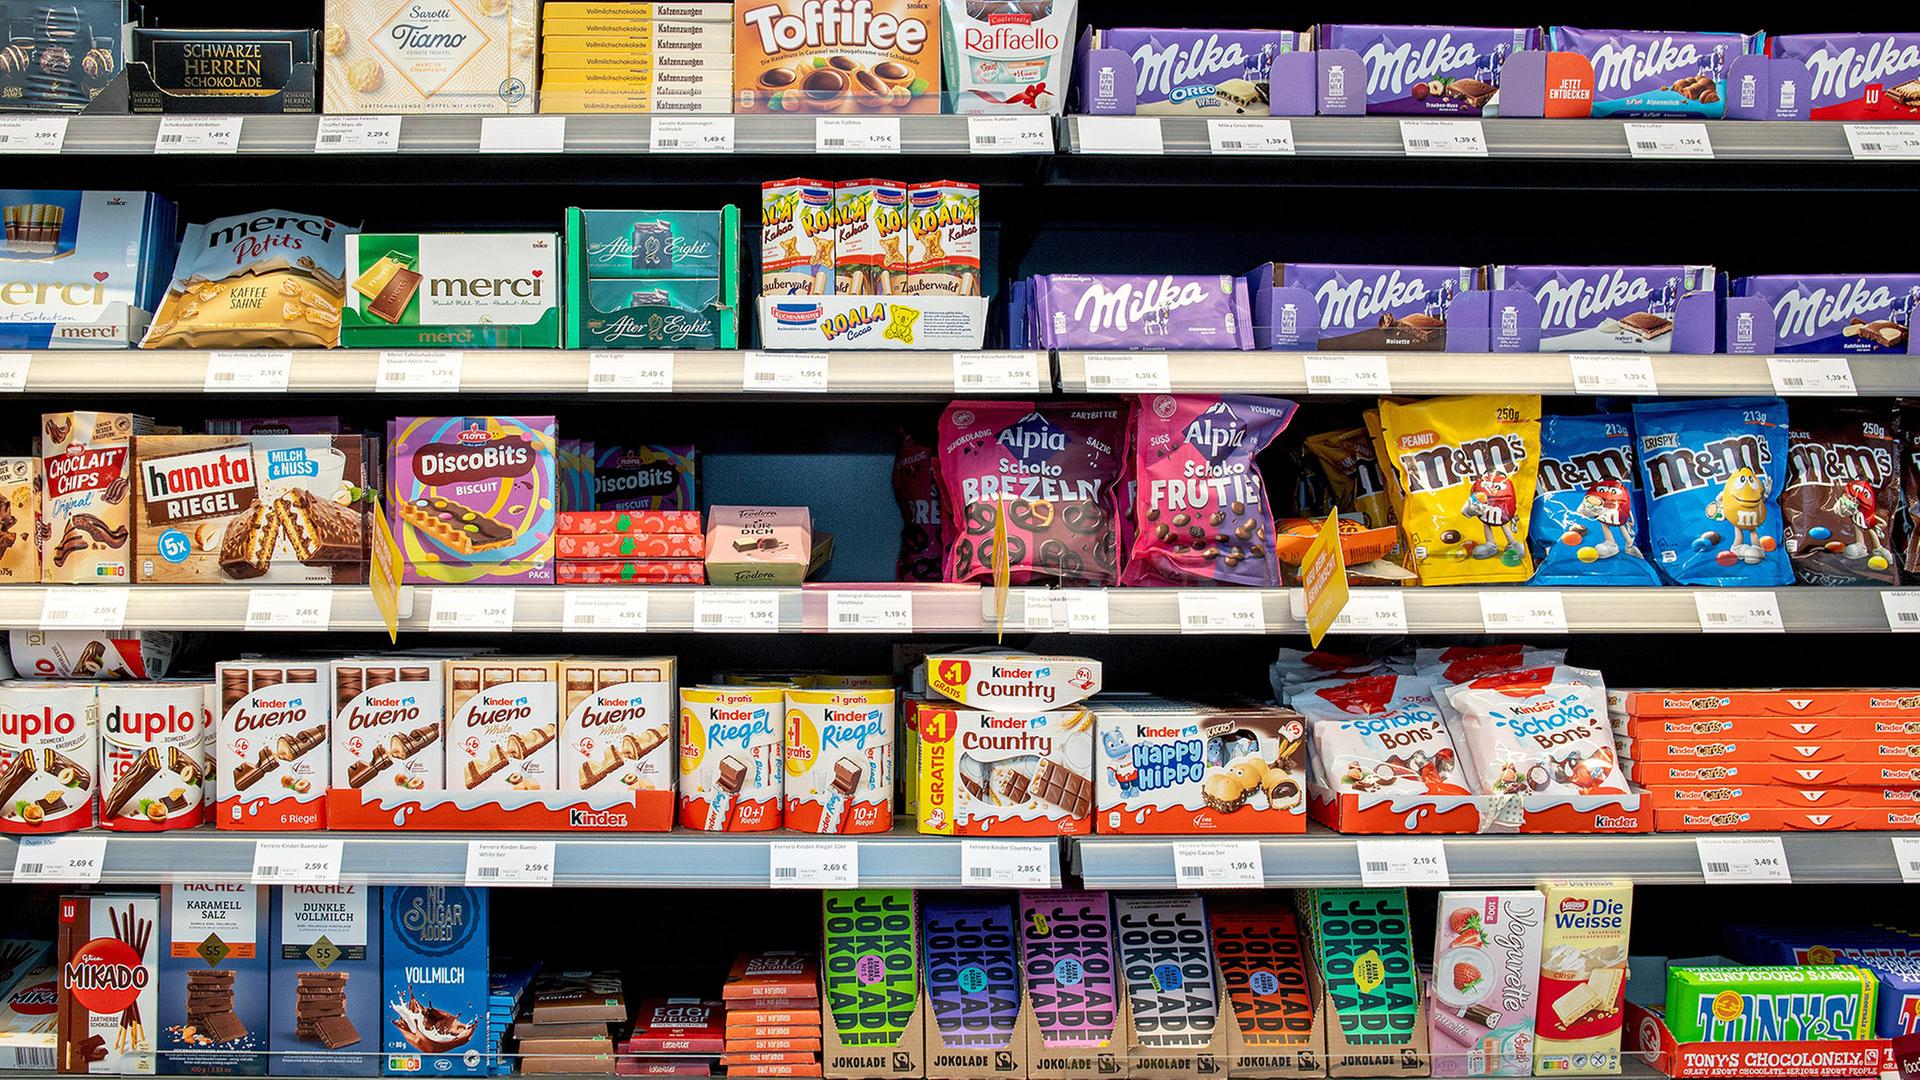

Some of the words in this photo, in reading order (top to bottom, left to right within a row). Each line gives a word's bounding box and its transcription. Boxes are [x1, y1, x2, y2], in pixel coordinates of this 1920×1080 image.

[409, 5, 451, 20] Sarotti
[586, 7, 647, 15] Vollmilchschokolade
[658, 6, 703, 16] Katzenzungen
[586, 25, 647, 33] Vollmilchschokolade
[658, 24, 703, 34] Katzenzungen
[744, 0, 928, 55] Toffifee
[391, 24, 467, 50] Tiamo
[585, 41, 646, 49] Vollmilchschokolade
[657, 40, 702, 50] Katzenzungen
[965, 27, 1059, 53] Raffaello
[183, 43, 262, 59] SCHWARZE
[184, 60, 262, 76] HERREN
[1131, 33, 1249, 96] Milka
[1362, 33, 1481, 96] Milka
[1592, 37, 1703, 93] Milka
[1805, 36, 1920, 101] Milka
[183, 77, 263, 88] SCHOKOLADE
[1559, 79, 1582, 90] JETZT
[1171, 84, 1217, 100] OREO
[1549, 89, 1591, 100] ENTDECKEN
[1866, 89, 1879, 104] LU
[1646, 98, 1680, 106] Alpenmilch
[209, 216, 336, 249] merci
[232, 233, 303, 265] Petits
[230, 287, 268, 299] KAFFEE
[1315, 269, 1428, 330] Milka
[1536, 268, 1654, 331] Milka
[230, 298, 263, 310] SAHNE
[1074, 275, 1209, 333] Milka
[1772, 277, 1896, 340] Milka
[592, 314, 648, 342] After
[663, 315, 713, 342] Eight
[820, 302, 886, 340] KOALA
[996, 425, 1066, 460] Alpia
[1183, 420, 1248, 458] Alpia
[1402, 433, 1435, 447] PEANUT
[1645, 434, 1676, 450] CRISPY
[271, 450, 303, 463] MILCH
[422, 445, 528, 477] DiscoBits
[49, 452, 115, 479] CHOCLAIT
[998, 457, 1063, 478] Schoko
[1183, 459, 1246, 480] Schoko
[148, 454, 251, 497] hanuta
[57, 472, 100, 498] CHIPS
[456, 481, 499, 497] BISCUIT
[962, 474, 1102, 508] BREZELN
[167, 491, 241, 519] RIEGEL
[741, 528, 774, 536] DICH
[528, 570, 550, 580] PACK
[1750, 609, 1766, 617] 3,99
[851, 679, 872, 687] gratis
[933, 679, 962, 700] GRATIS
[715, 694, 725, 703] +1
[831, 695, 840, 704] +1
[976, 680, 1057, 703] Country
[252, 698, 287, 709] Kinder
[366, 696, 400, 708] Kinder
[483, 696, 513, 707] Kinder
[597, 696, 627, 707] Kinder
[106, 704, 195, 744] duplo
[234, 706, 308, 734] bueno
[348, 705, 420, 732] bueno
[467, 706, 532, 729] bueno
[980, 714, 1028, 730] Kinder
[707, 711, 775, 752] Riegel
[822, 712, 886, 753] Riegel
[1378, 727, 1434, 751] Bons
[1532, 724, 1592, 750] Bons
[962, 731, 1053, 757] Country
[1132, 739, 1204, 769] Happy
[930, 745, 946, 806] GRATIS
[1138, 761, 1205, 791] Hippo
[570, 809, 628, 827] Kinder
[740, 817, 762, 826] Riegel
[25, 839, 42, 847] Duplo
[69, 859, 87, 867] 2,69
[88, 859, 94, 867] €
[525, 864, 542, 872] 2,59
[543, 864, 549, 872] €
[823, 863, 841, 871] 2,69
[842, 863, 847, 871] €
[1017, 864, 1034, 873] 2,85
[1036, 864, 1042, 873] €
[1230, 862, 1248, 870] 1,99
[1249, 862, 1255, 870] €
[1413, 856, 1430, 865] 2,19
[1431, 856, 1437, 865] €
[1754, 857, 1771, 866] 3,49
[1772, 857, 1778, 866] €
[187, 900, 242, 910] KARAMELL
[303, 903, 346, 912] DUNKLE
[1592, 899, 1625, 916] Die
[201, 909, 227, 919] SALZ
[294, 912, 354, 922] VOLLMILCH
[1555, 912, 1623, 930] Weisse
[65, 962, 149, 990] MIKADO
[405, 966, 465, 984] VOLLMILCH
[538, 992, 583, 1001] Mandel
[90, 1015, 119, 1023] ZARTHERBE
[832, 1056, 886, 1068] JOKOLADE
[933, 1055, 989, 1067] JOKOLADE
[1137, 1057, 1191, 1069] JOKOLADE
[1237, 1055, 1292, 1068] JOKOLADE
[1341, 1054, 1395, 1067] JOKOLADE
[1683, 1068, 1712, 1076] CRAZY
[1713, 1068, 1738, 1076] ABOUT
[1786, 1068, 1816, 1076] SERIOUS
[1817, 1068, 1846, 1076] ABOUT
[1847, 1067, 1878, 1076] PEOPLE
